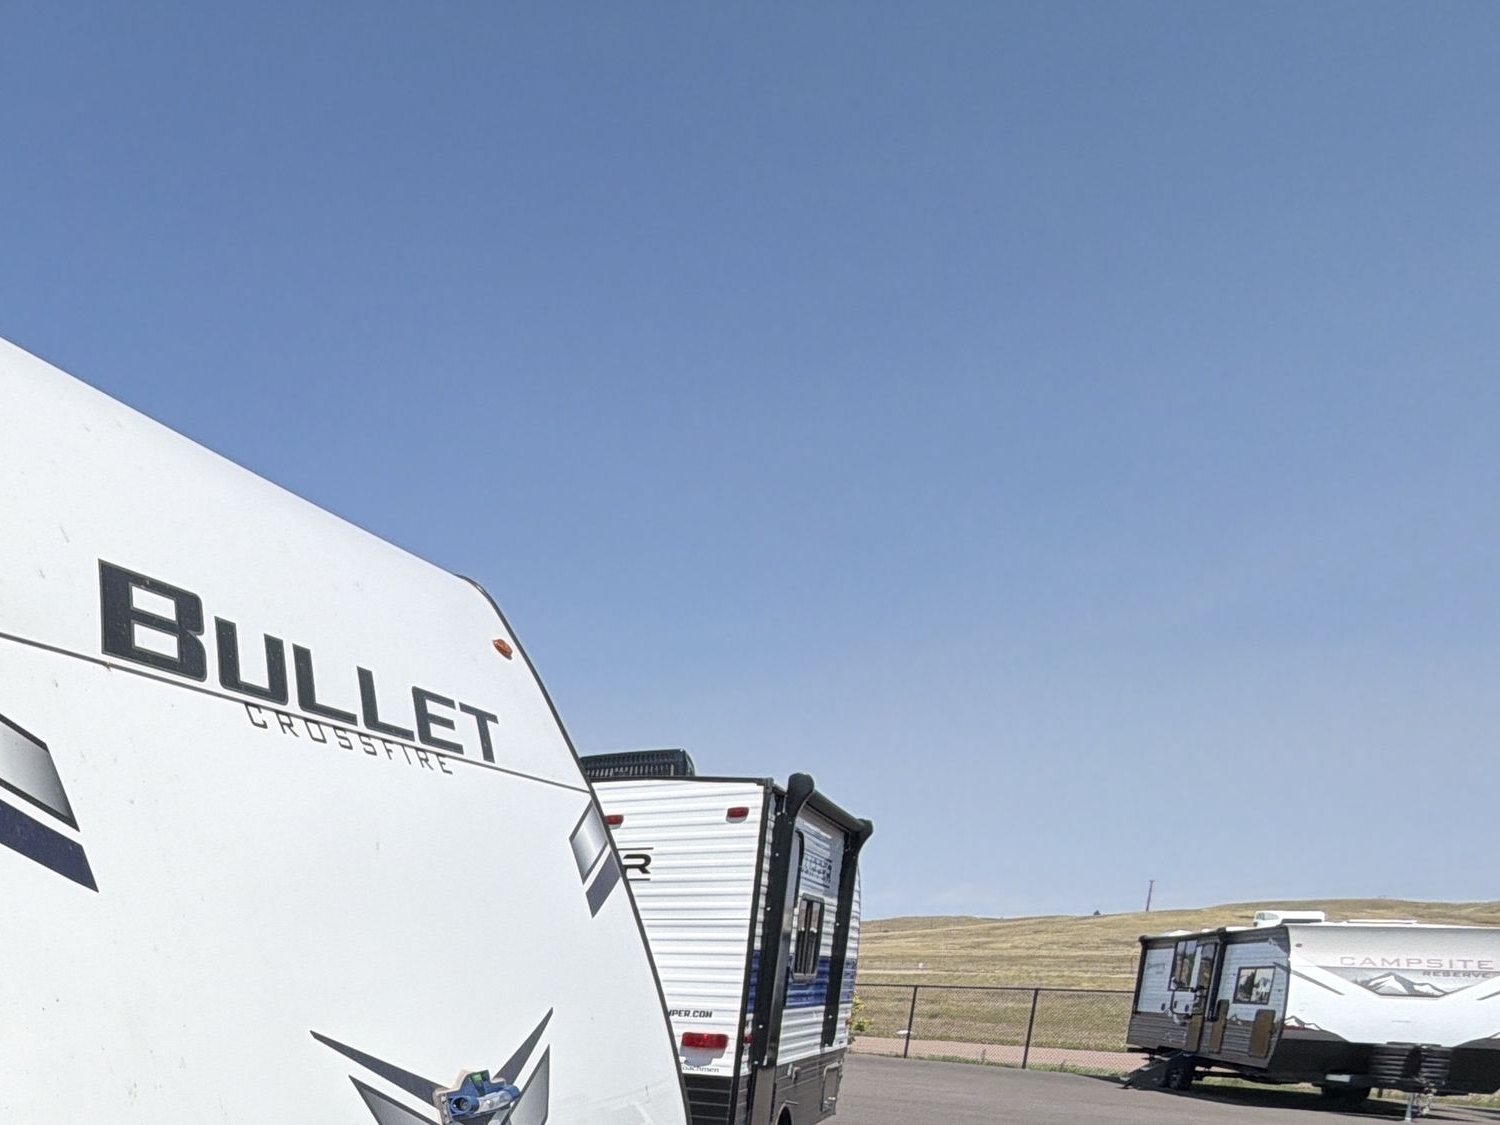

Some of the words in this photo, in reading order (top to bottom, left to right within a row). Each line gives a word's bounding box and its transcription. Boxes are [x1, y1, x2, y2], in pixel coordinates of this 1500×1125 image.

[98, 558, 499, 763] BULLET
[244, 702, 453, 775] CROSSFIRE
[1340, 956, 1494, 970] CAMPSITE
[1422, 970, 1493, 979] RESERVE
[682, 1065, 720, 1073] oachmen
